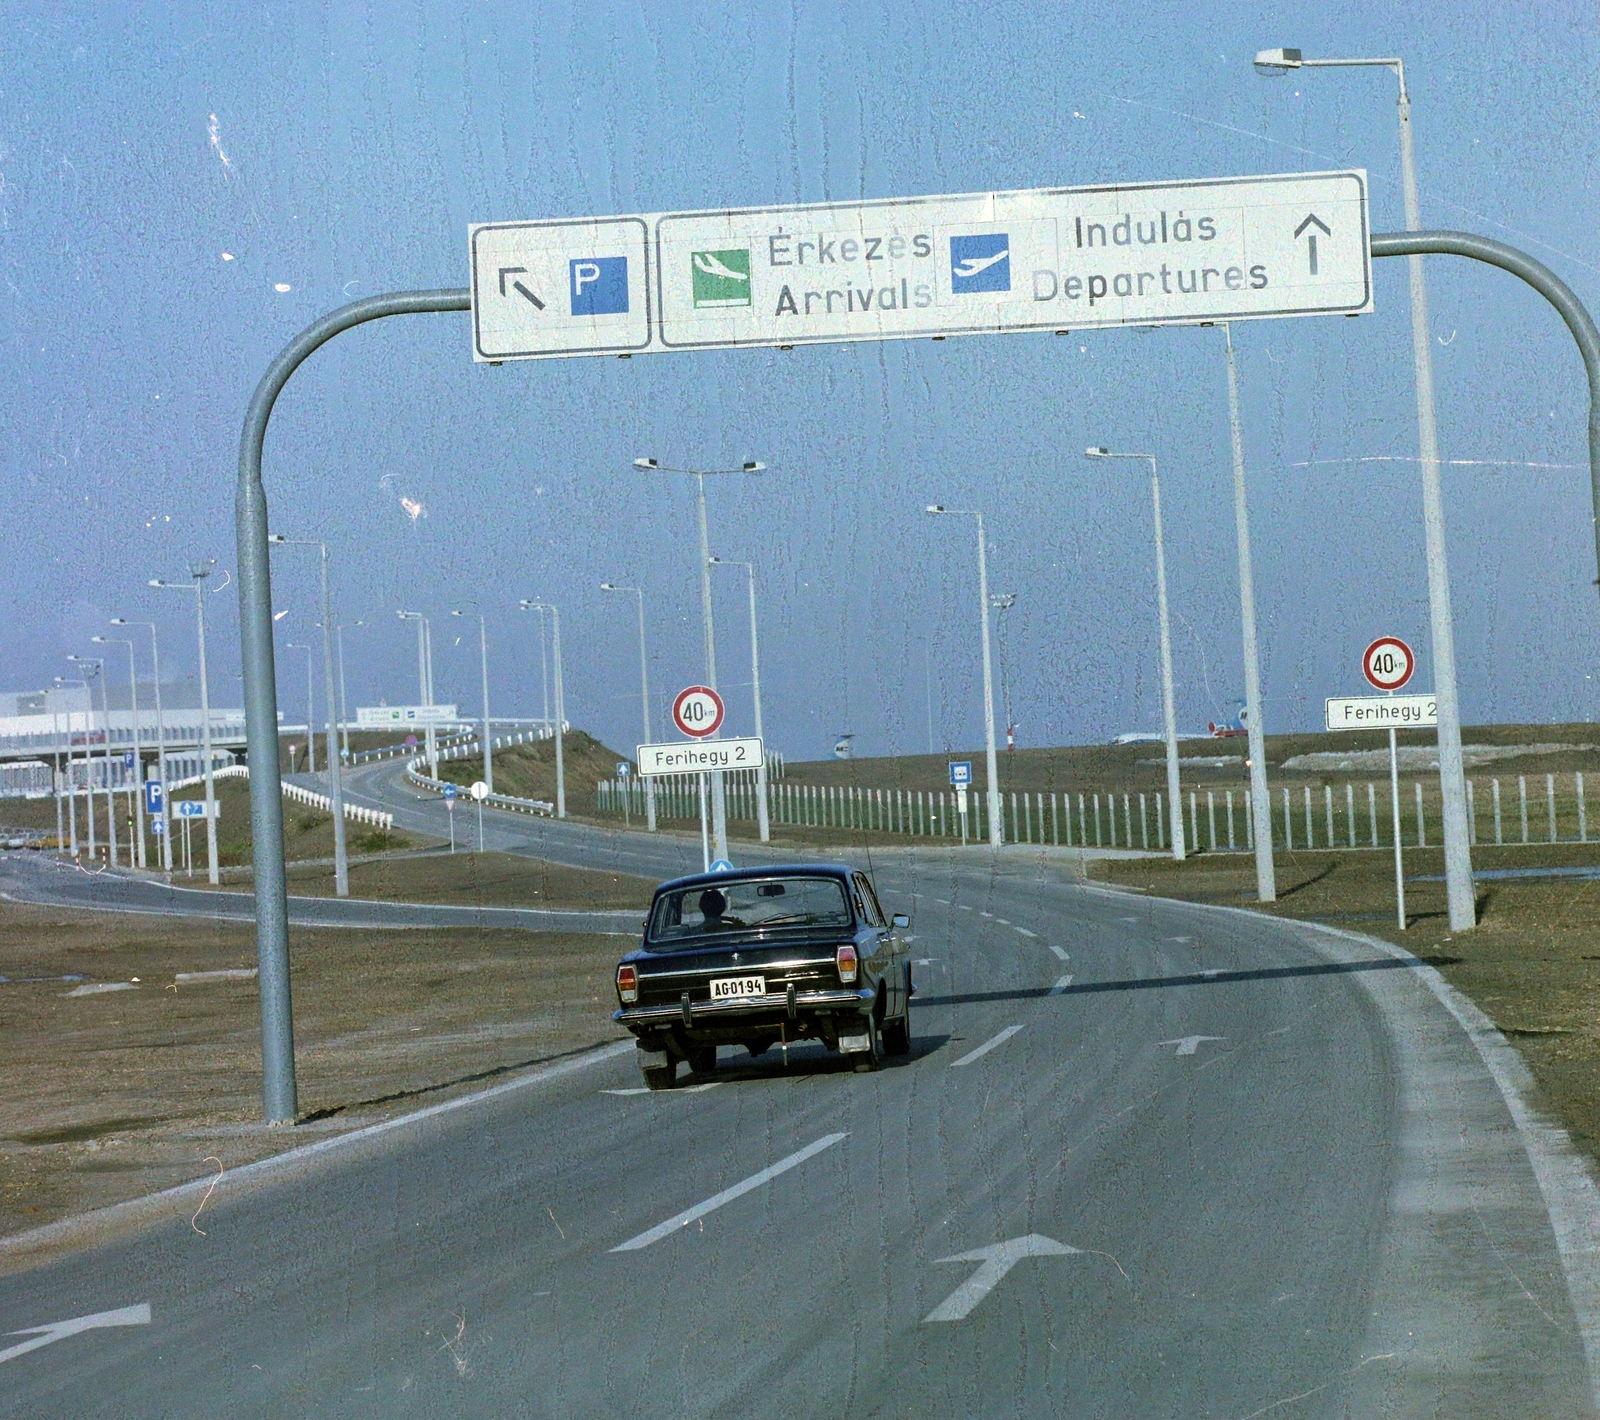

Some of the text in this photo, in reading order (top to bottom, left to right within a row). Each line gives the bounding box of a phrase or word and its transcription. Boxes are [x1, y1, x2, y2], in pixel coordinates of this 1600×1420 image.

[1075, 211, 1216, 248] Indulás
[769, 227, 931, 266] Érkezés
[574, 264, 600, 295] P
[1032, 264, 1268, 306] Departures
[775, 279, 932, 316] Arrivals
[1373, 653, 1393, 674] 40
[683, 701, 704, 722] 40
[1344, 702, 1437, 721] Ferihegy 2
[126, 754, 132, 764] P
[655, 746, 746, 766] Ferihegy 2
[150, 785, 161, 803] P
